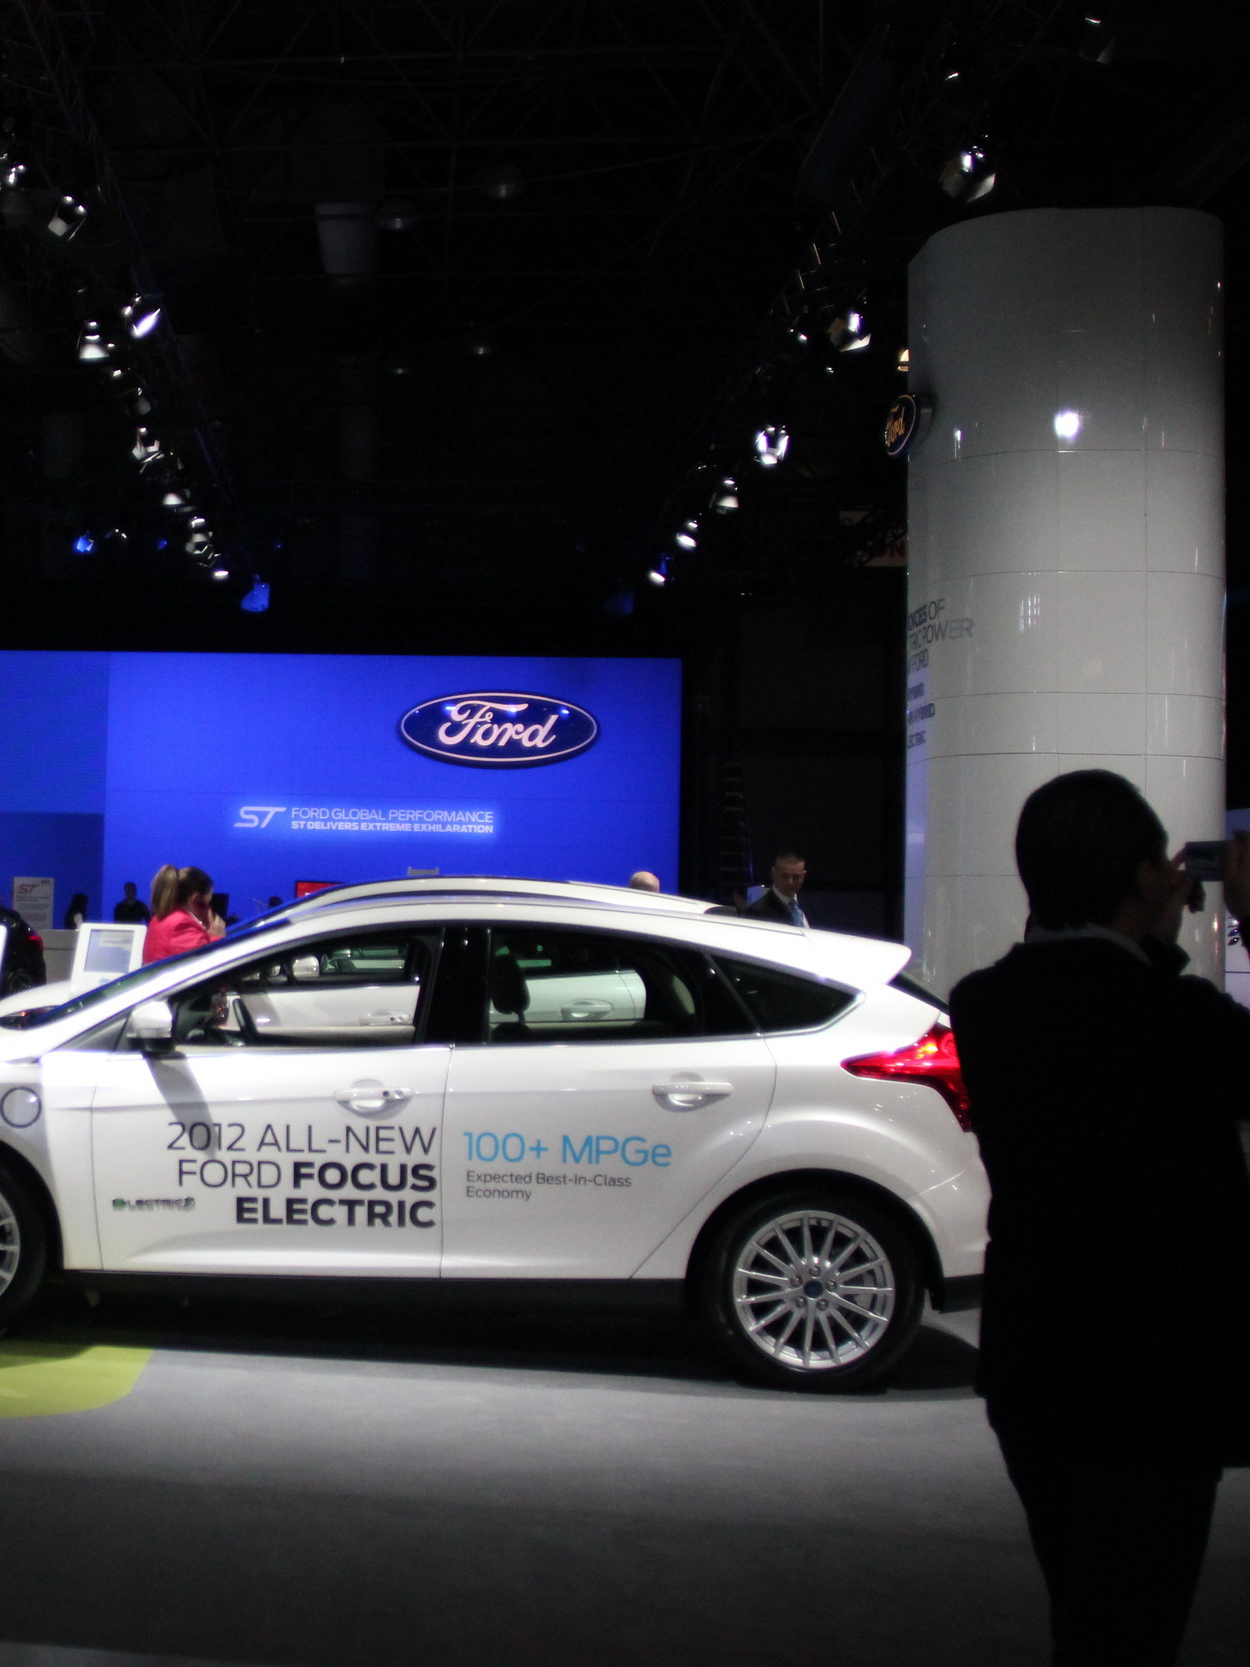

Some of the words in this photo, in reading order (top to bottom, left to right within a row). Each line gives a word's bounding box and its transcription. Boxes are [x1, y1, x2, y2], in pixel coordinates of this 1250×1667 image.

[929, 598, 946, 620] OF
[922, 618, 974, 648] POWER
[438, 700, 559, 747] Ford
[234, 806, 287, 828] ST
[291, 807, 329, 819] FORD
[332, 808, 386, 821] GLOBAL
[389, 809, 494, 823] PERFORMANCE
[291, 821, 304, 830] ST
[307, 821, 359, 831] DELIVERS
[360, 822, 412, 832] EXTREME
[413, 823, 494, 834] EXHILARATION
[167, 1122, 246, 1152] 2012
[257, 1124, 437, 1155] ALL-NEW
[463, 1131, 549, 1163] 100+
[562, 1134, 672, 1168] MPGe
[178, 1159, 281, 1189] FORD
[293, 1161, 437, 1193] FOCUS
[466, 1170, 532, 1185] Expected
[536, 1172, 632, 1188] Best-In-Class
[466, 1186, 532, 1201] Economy
[236, 1196, 437, 1229] ELECTRIC
